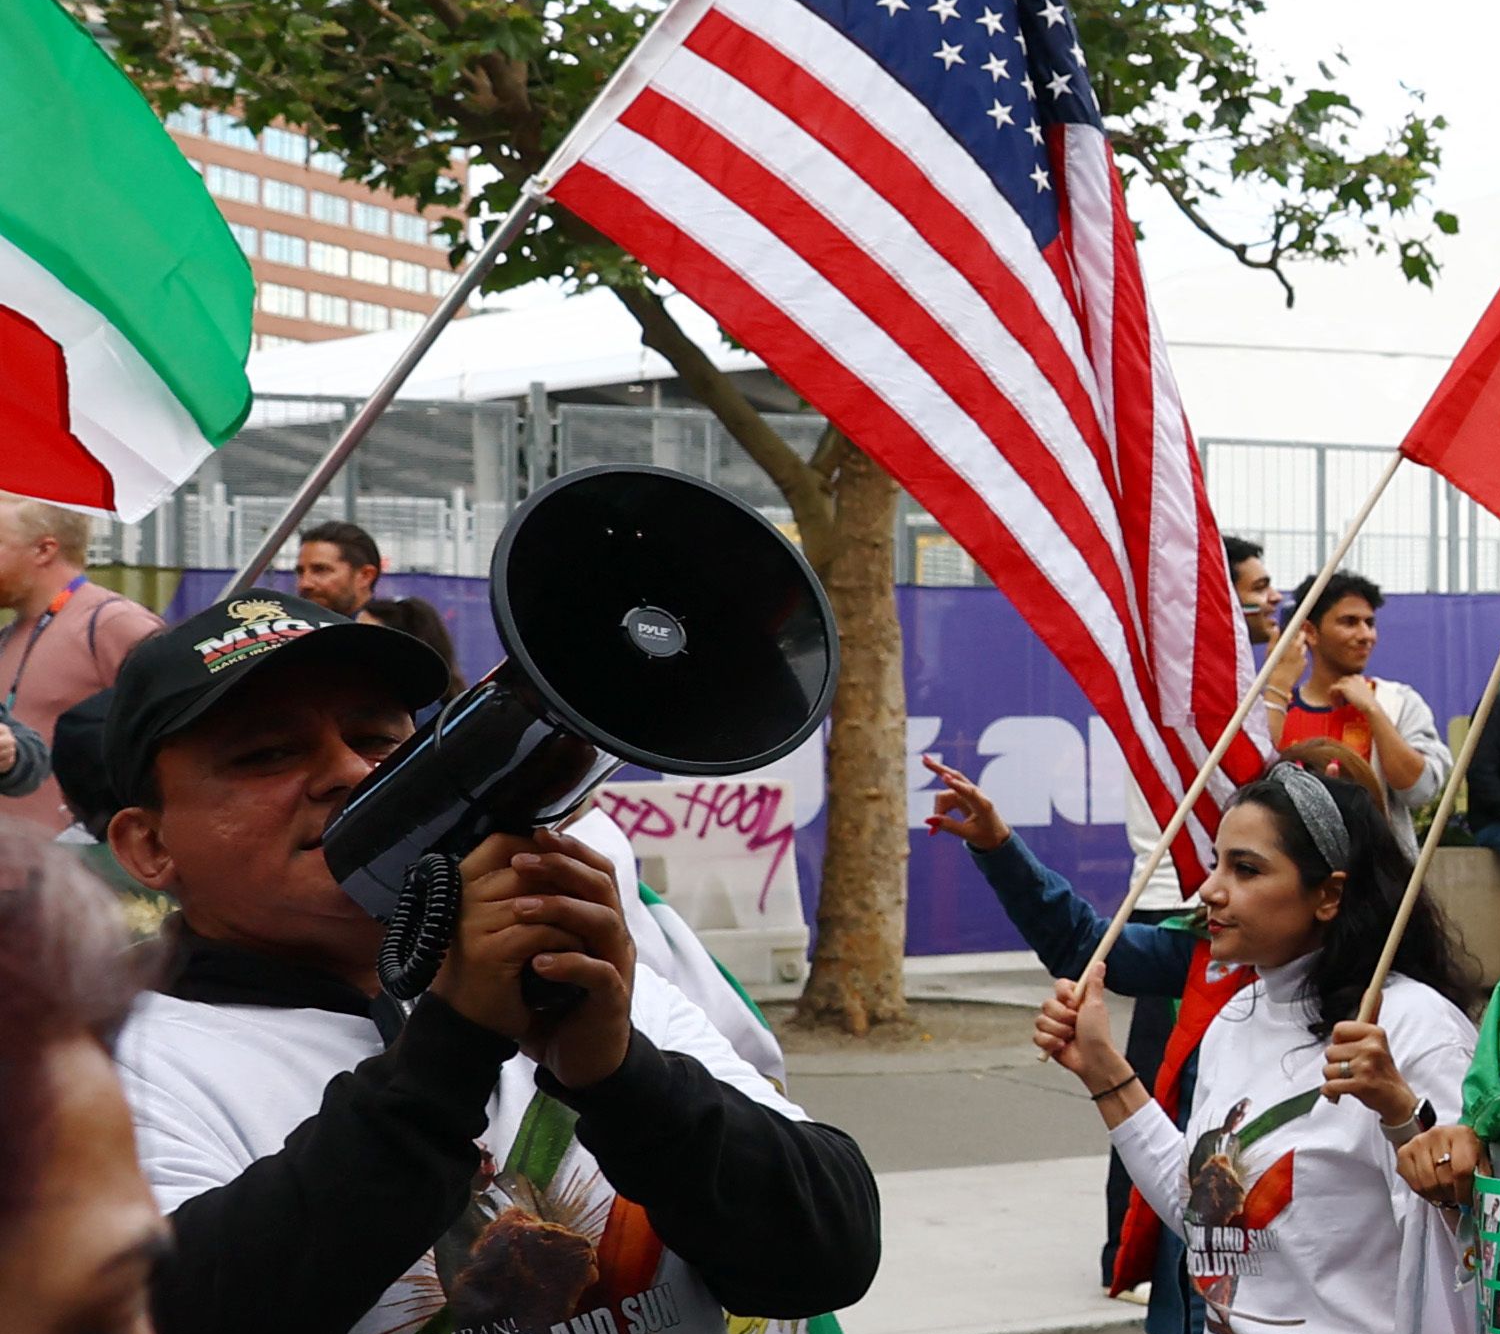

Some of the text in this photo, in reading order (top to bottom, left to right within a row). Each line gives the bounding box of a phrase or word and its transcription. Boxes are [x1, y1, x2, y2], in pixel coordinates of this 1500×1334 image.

[193, 618, 336, 665] MIG
[638, 622, 672, 638] PYLE
[210, 650, 248, 674] MAKE
[1212, 1226, 1245, 1252] AND
